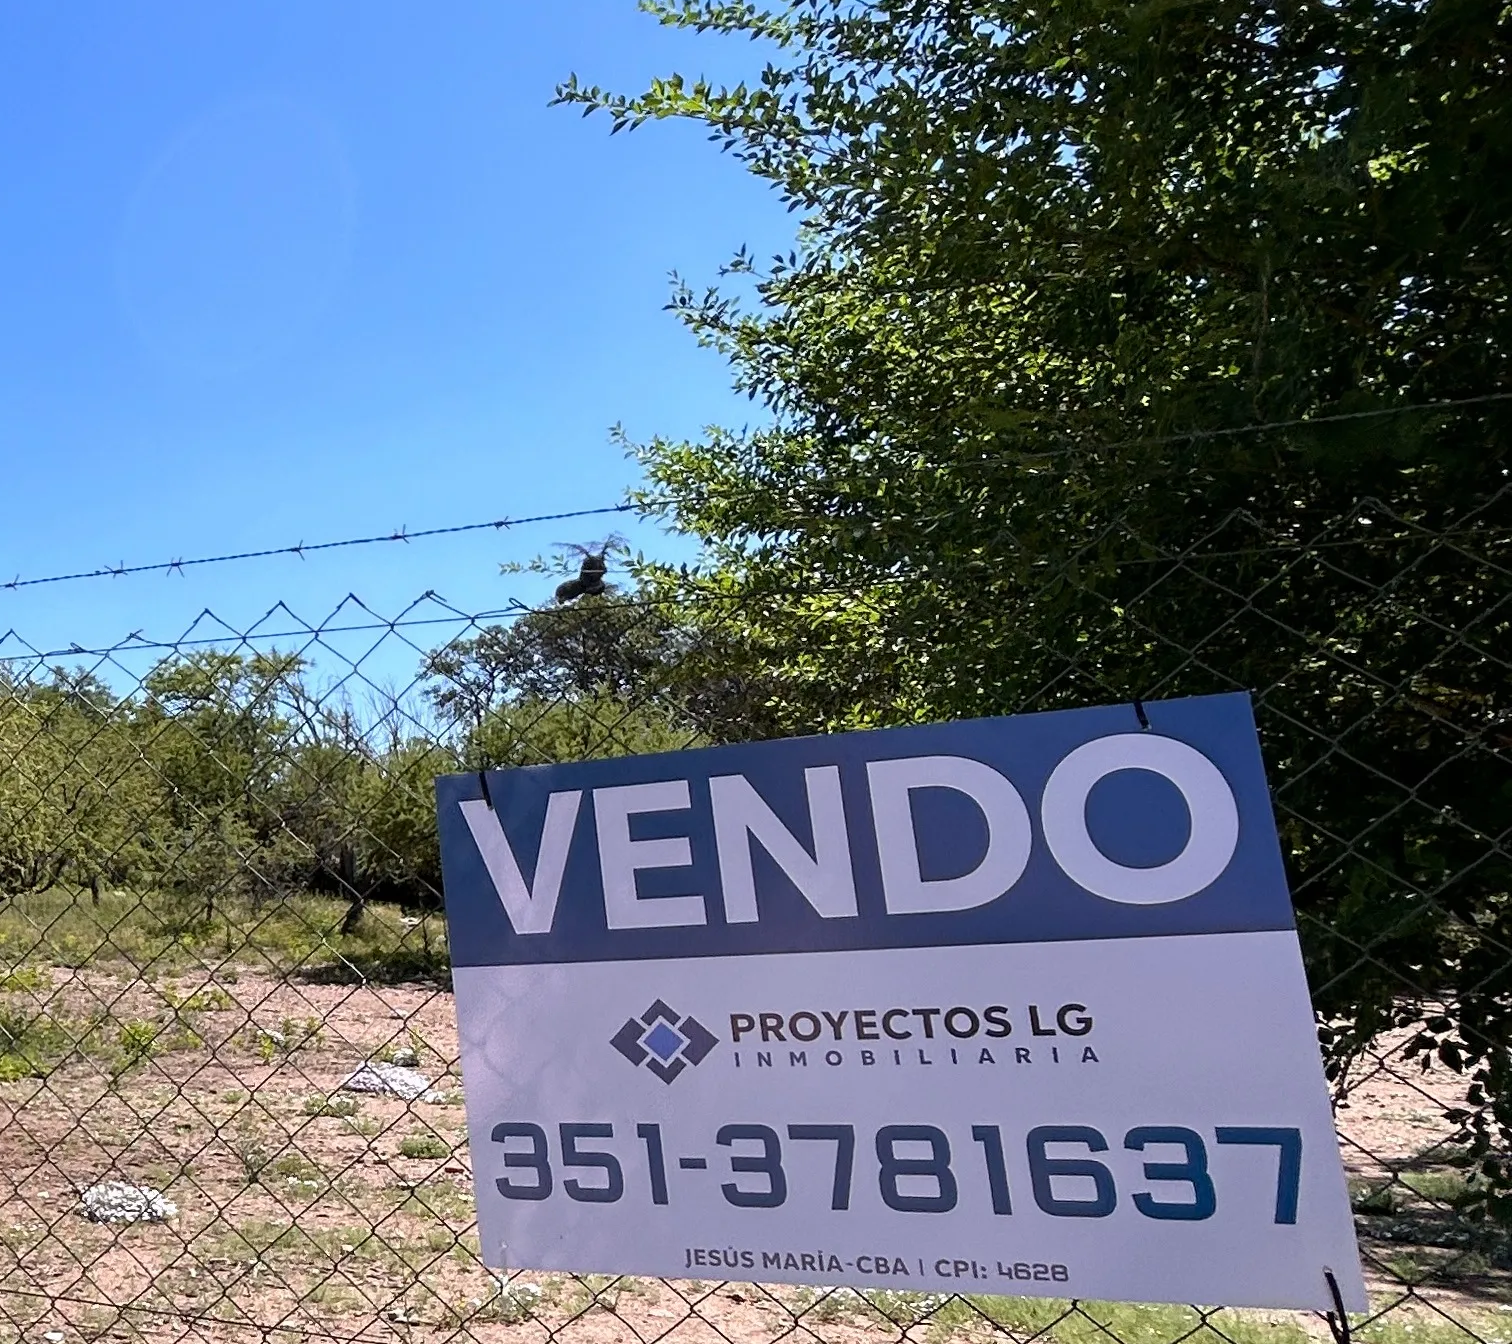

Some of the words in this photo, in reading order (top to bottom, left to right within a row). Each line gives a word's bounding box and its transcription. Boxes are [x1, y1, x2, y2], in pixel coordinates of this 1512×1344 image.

[458, 732, 1240, 935] VENDO
[729, 1005, 1013, 1043] PROYECTOS
[1028, 1003, 1094, 1038] LG
[733, 1045, 1100, 1068] INMOBILIARIA
[491, 1122, 1301, 1225] 351-3781637
[685, 1245, 755, 1269] JESÚS
[762, 1250, 910, 1277] MARÍA-CBA
[934, 1259, 988, 1280] CPI:
[997, 1263, 1070, 1283] 4628
